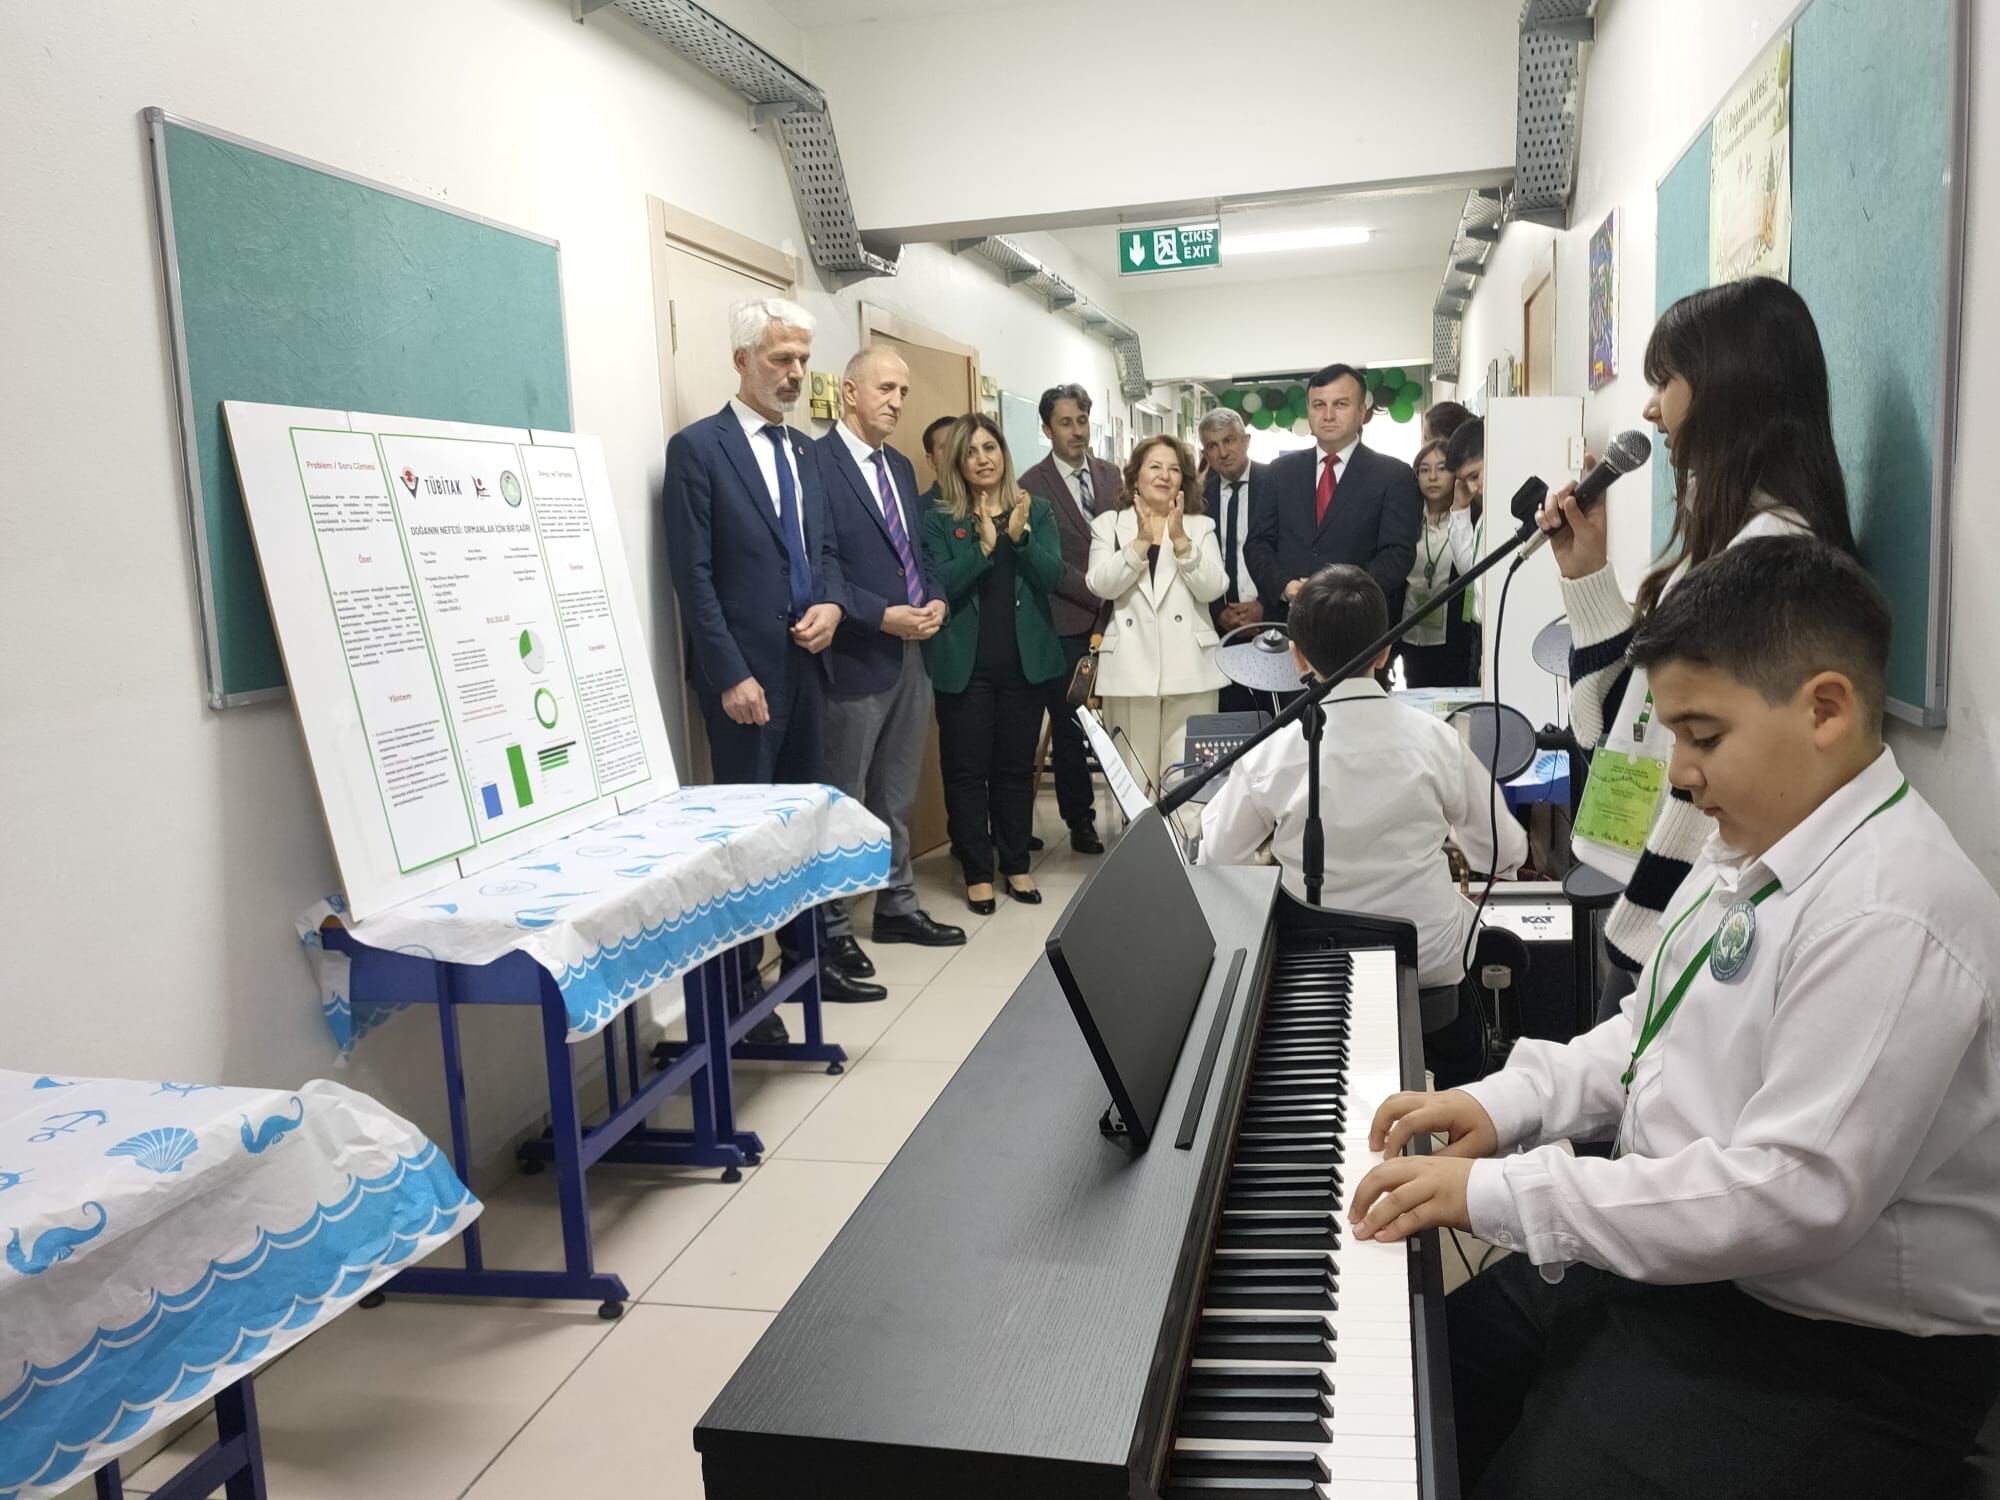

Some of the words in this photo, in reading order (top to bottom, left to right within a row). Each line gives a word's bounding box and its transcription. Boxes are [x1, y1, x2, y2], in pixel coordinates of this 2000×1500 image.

[1181, 229, 1213, 245] ÇIKIŞ
[1184, 245, 1212, 259] EXIT
[305, 461, 333, 470] Problem
[424, 476, 463, 495] TÜBİTAK
[410, 524, 439, 536] DOĞANIN
[464, 524, 495, 534] ORMANLAR
